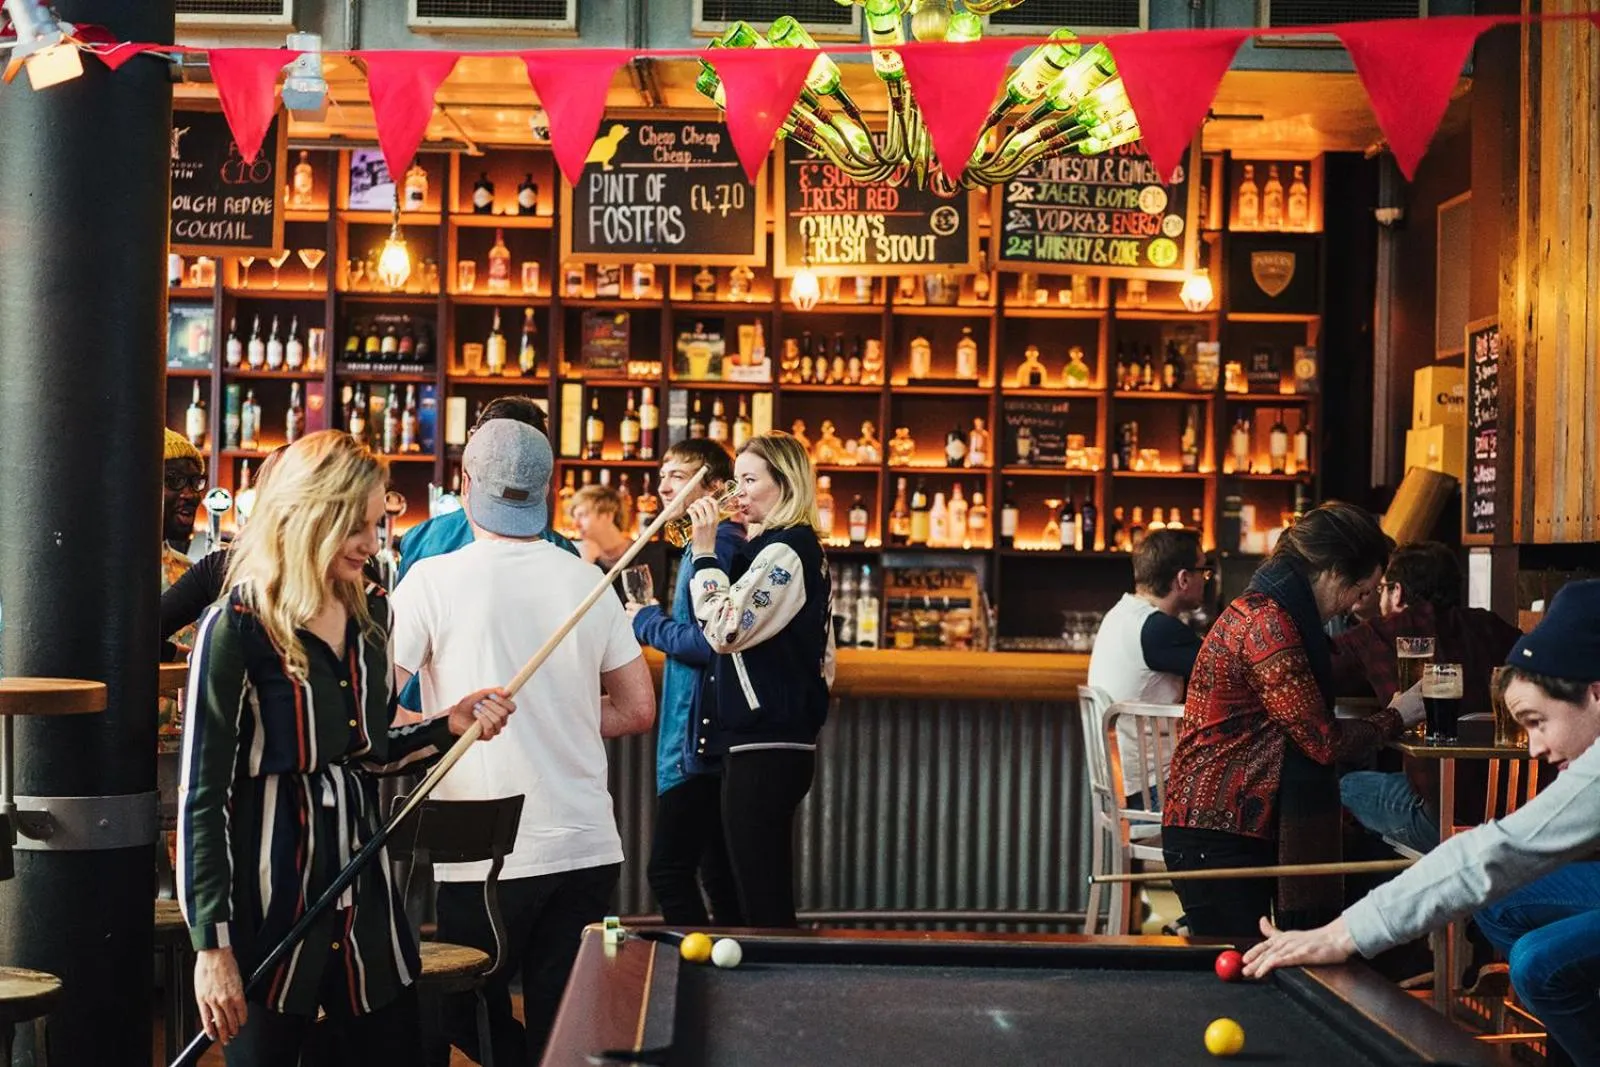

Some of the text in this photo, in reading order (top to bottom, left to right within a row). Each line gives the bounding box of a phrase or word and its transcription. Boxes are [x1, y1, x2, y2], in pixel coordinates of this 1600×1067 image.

[639, 126, 720, 152] Cheap Cheap
[1036, 158, 1099, 182] JAMESON
[1101, 158, 1114, 182] &
[1119, 158, 1162, 184] GINGE
[589, 173, 668, 204] PINT OF
[800, 188, 899, 212] IRISH RED
[1006, 182, 1034, 204] 2x
[1035, 183, 1090, 206] JAGER
[176, 220, 253, 240] COCKTAIL
[588, 206, 686, 244] FOSTERS
[800, 214, 886, 239] O'HARA'S
[1006, 209, 1032, 231] 2x
[1036, 210, 1096, 234] VODKA
[1096, 212, 1110, 234] &
[1112, 212, 1165, 235] ENERGY
[875, 234, 938, 263] STOUT
[1006, 236, 1032, 257] 2x
[1034, 235, 1092, 262] WHISKEY
[1092, 239, 1108, 263] &
[1108, 240, 1140, 266] COKE
